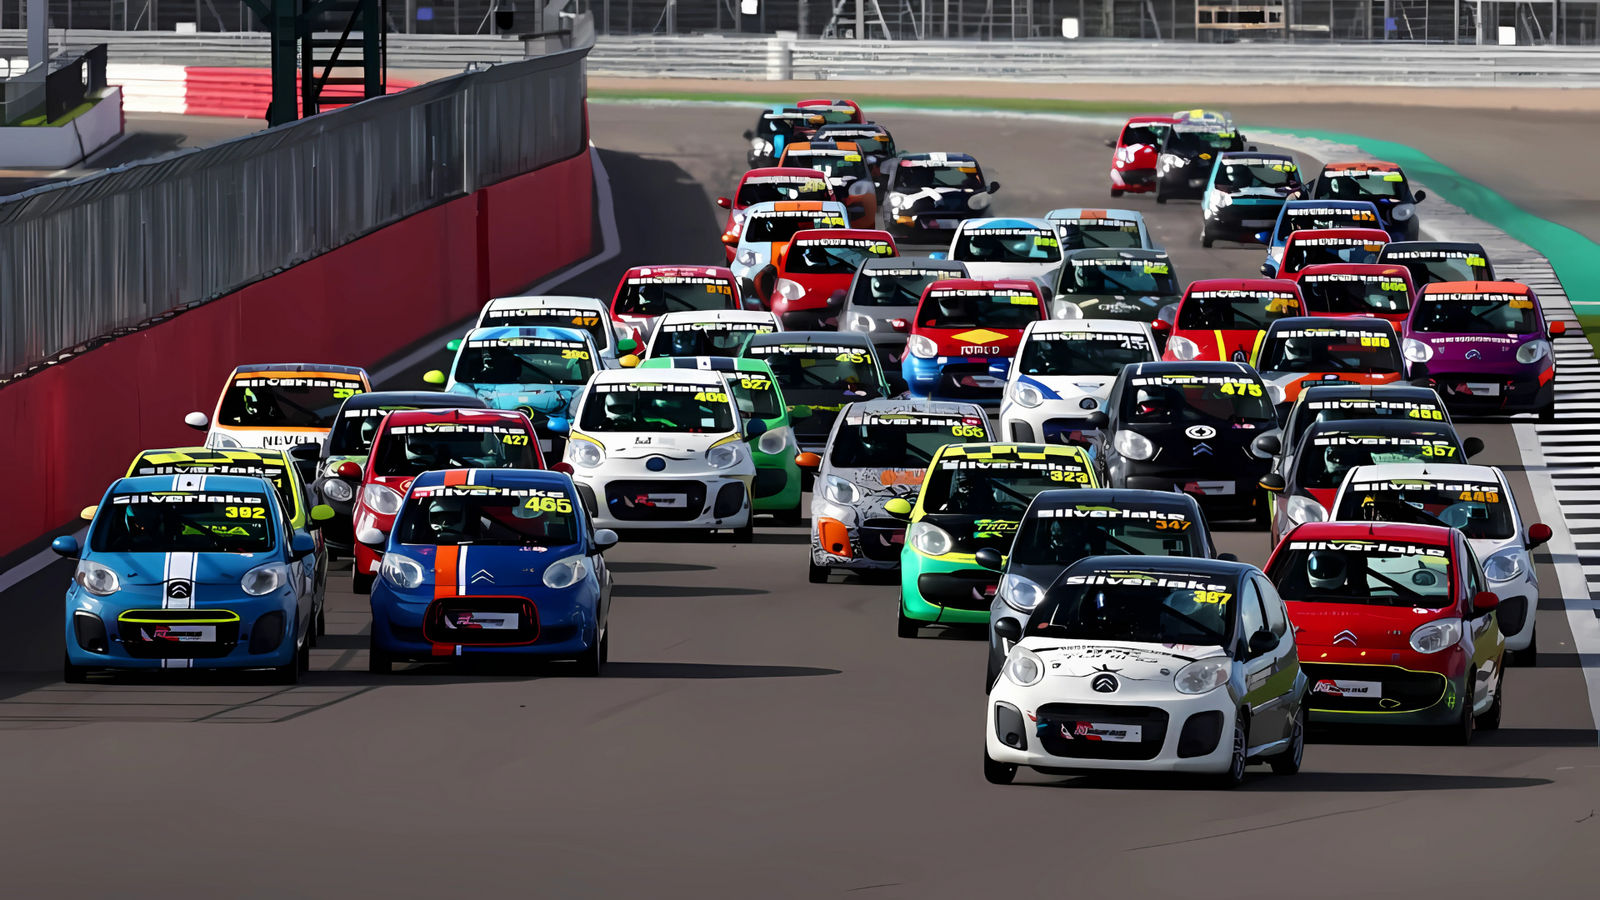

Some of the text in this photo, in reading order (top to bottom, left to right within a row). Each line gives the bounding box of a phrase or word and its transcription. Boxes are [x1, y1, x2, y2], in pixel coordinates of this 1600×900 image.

[1220, 382, 1262, 397] 475
[1050, 471, 1089, 484] 323
[525, 497, 572, 514] 465
[1289, 542, 1445, 557] silverlake
[1066, 575, 1226, 591] silverlake
